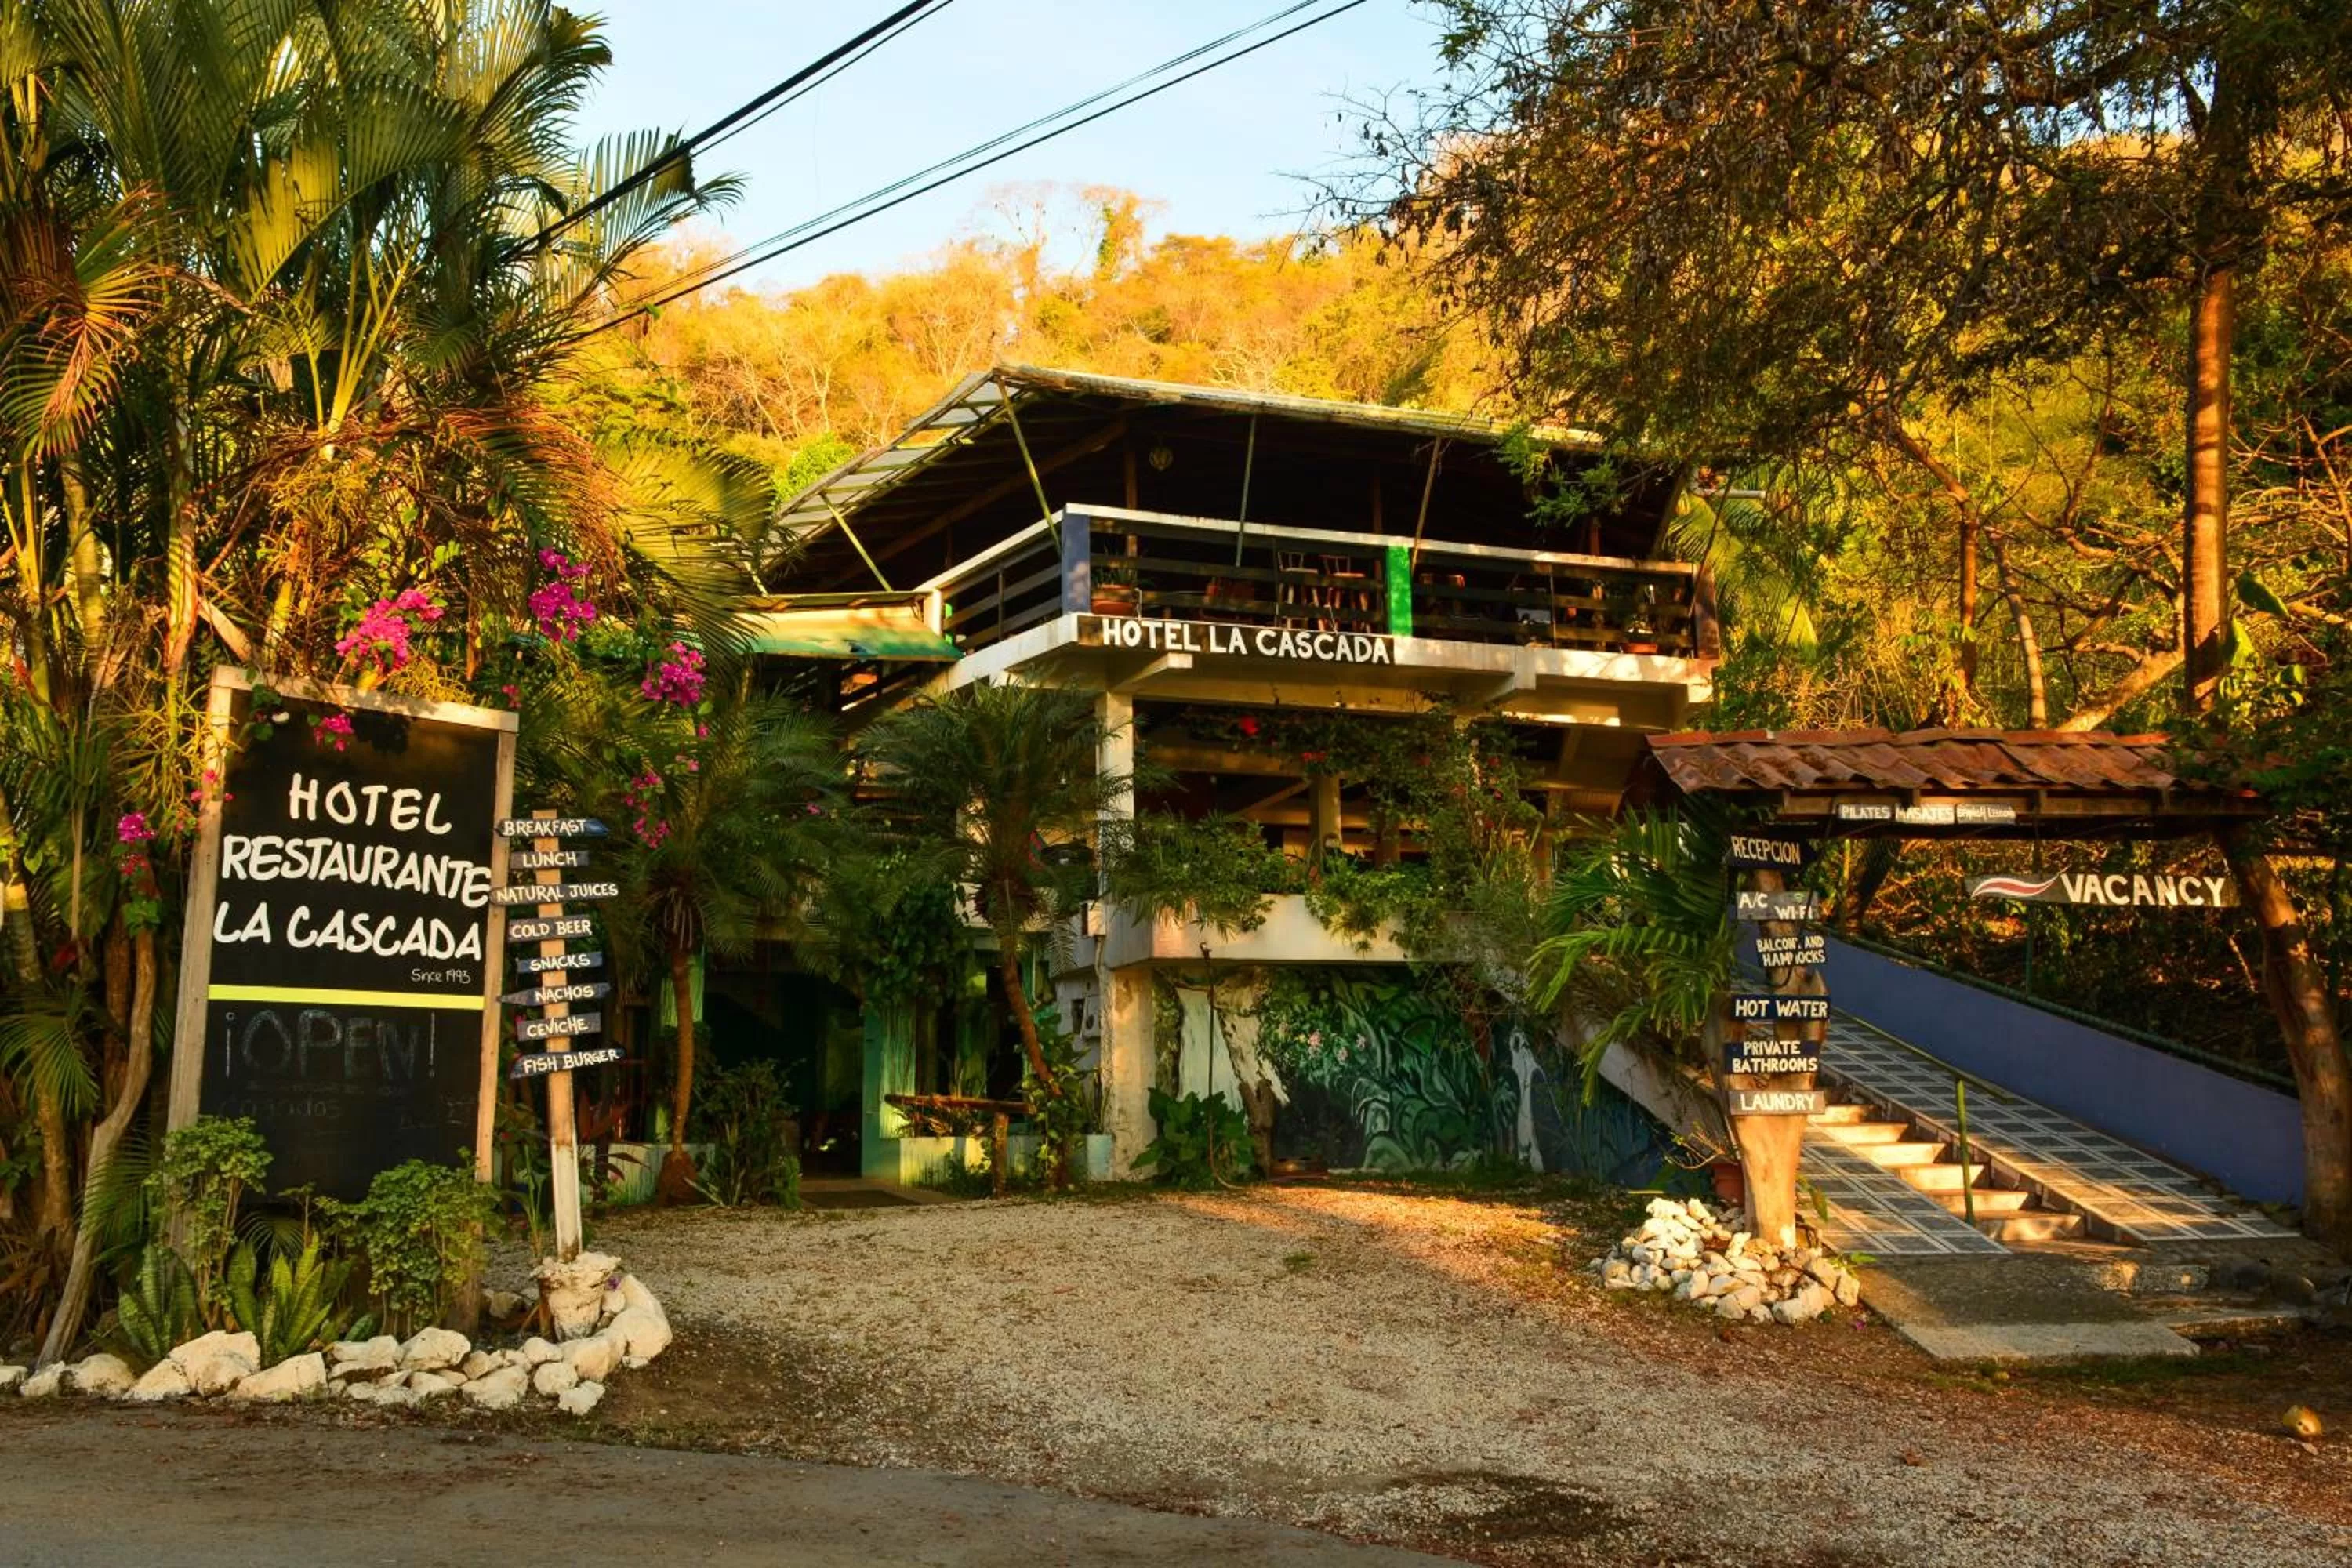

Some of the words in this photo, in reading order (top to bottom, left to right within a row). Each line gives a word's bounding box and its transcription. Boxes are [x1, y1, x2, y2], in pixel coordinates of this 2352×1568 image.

[1102, 618, 1200, 652] HOTEL
[1210, 627, 1248, 655] LA
[1255, 630, 1391, 664] CASCADA
[288, 773, 453, 835] HOTEL
[1842, 805, 1891, 819] PILATES
[502, 819, 586, 837] BREAKFAST
[523, 851, 578, 868] LUNCH
[1730, 836, 1801, 865] RECEPCION
[221, 835, 492, 909] RESTAURANTE
[496, 885, 564, 903] NATURAL
[568, 884, 619, 898] JUICES
[2060, 873, 2226, 907] VACANCY
[1739, 891, 1768, 909] A/C
[212, 902, 272, 944] LA
[287, 905, 482, 961] CASCADA
[511, 923, 549, 938] COLD
[555, 920, 593, 935] BEER
[1805, 935, 1824, 949] AND
[529, 953, 591, 971] SNACKS
[411, 968, 442, 983] Since
[445, 968, 471, 984] 1993
[535, 985, 595, 1003] NACHOS
[1735, 999, 1769, 1017] HOT
[1776, 1000, 1828, 1017] WATER
[526, 1016, 589, 1037] CEVICHE
[1743, 1040, 1801, 1056] PRIVATE
[523, 1056, 557, 1074] FISH
[563, 1048, 620, 1070] BURGER
[1732, 1057, 1818, 1073] BATHROOMS
[1740, 1094, 1816, 1111] LAUNDRY
